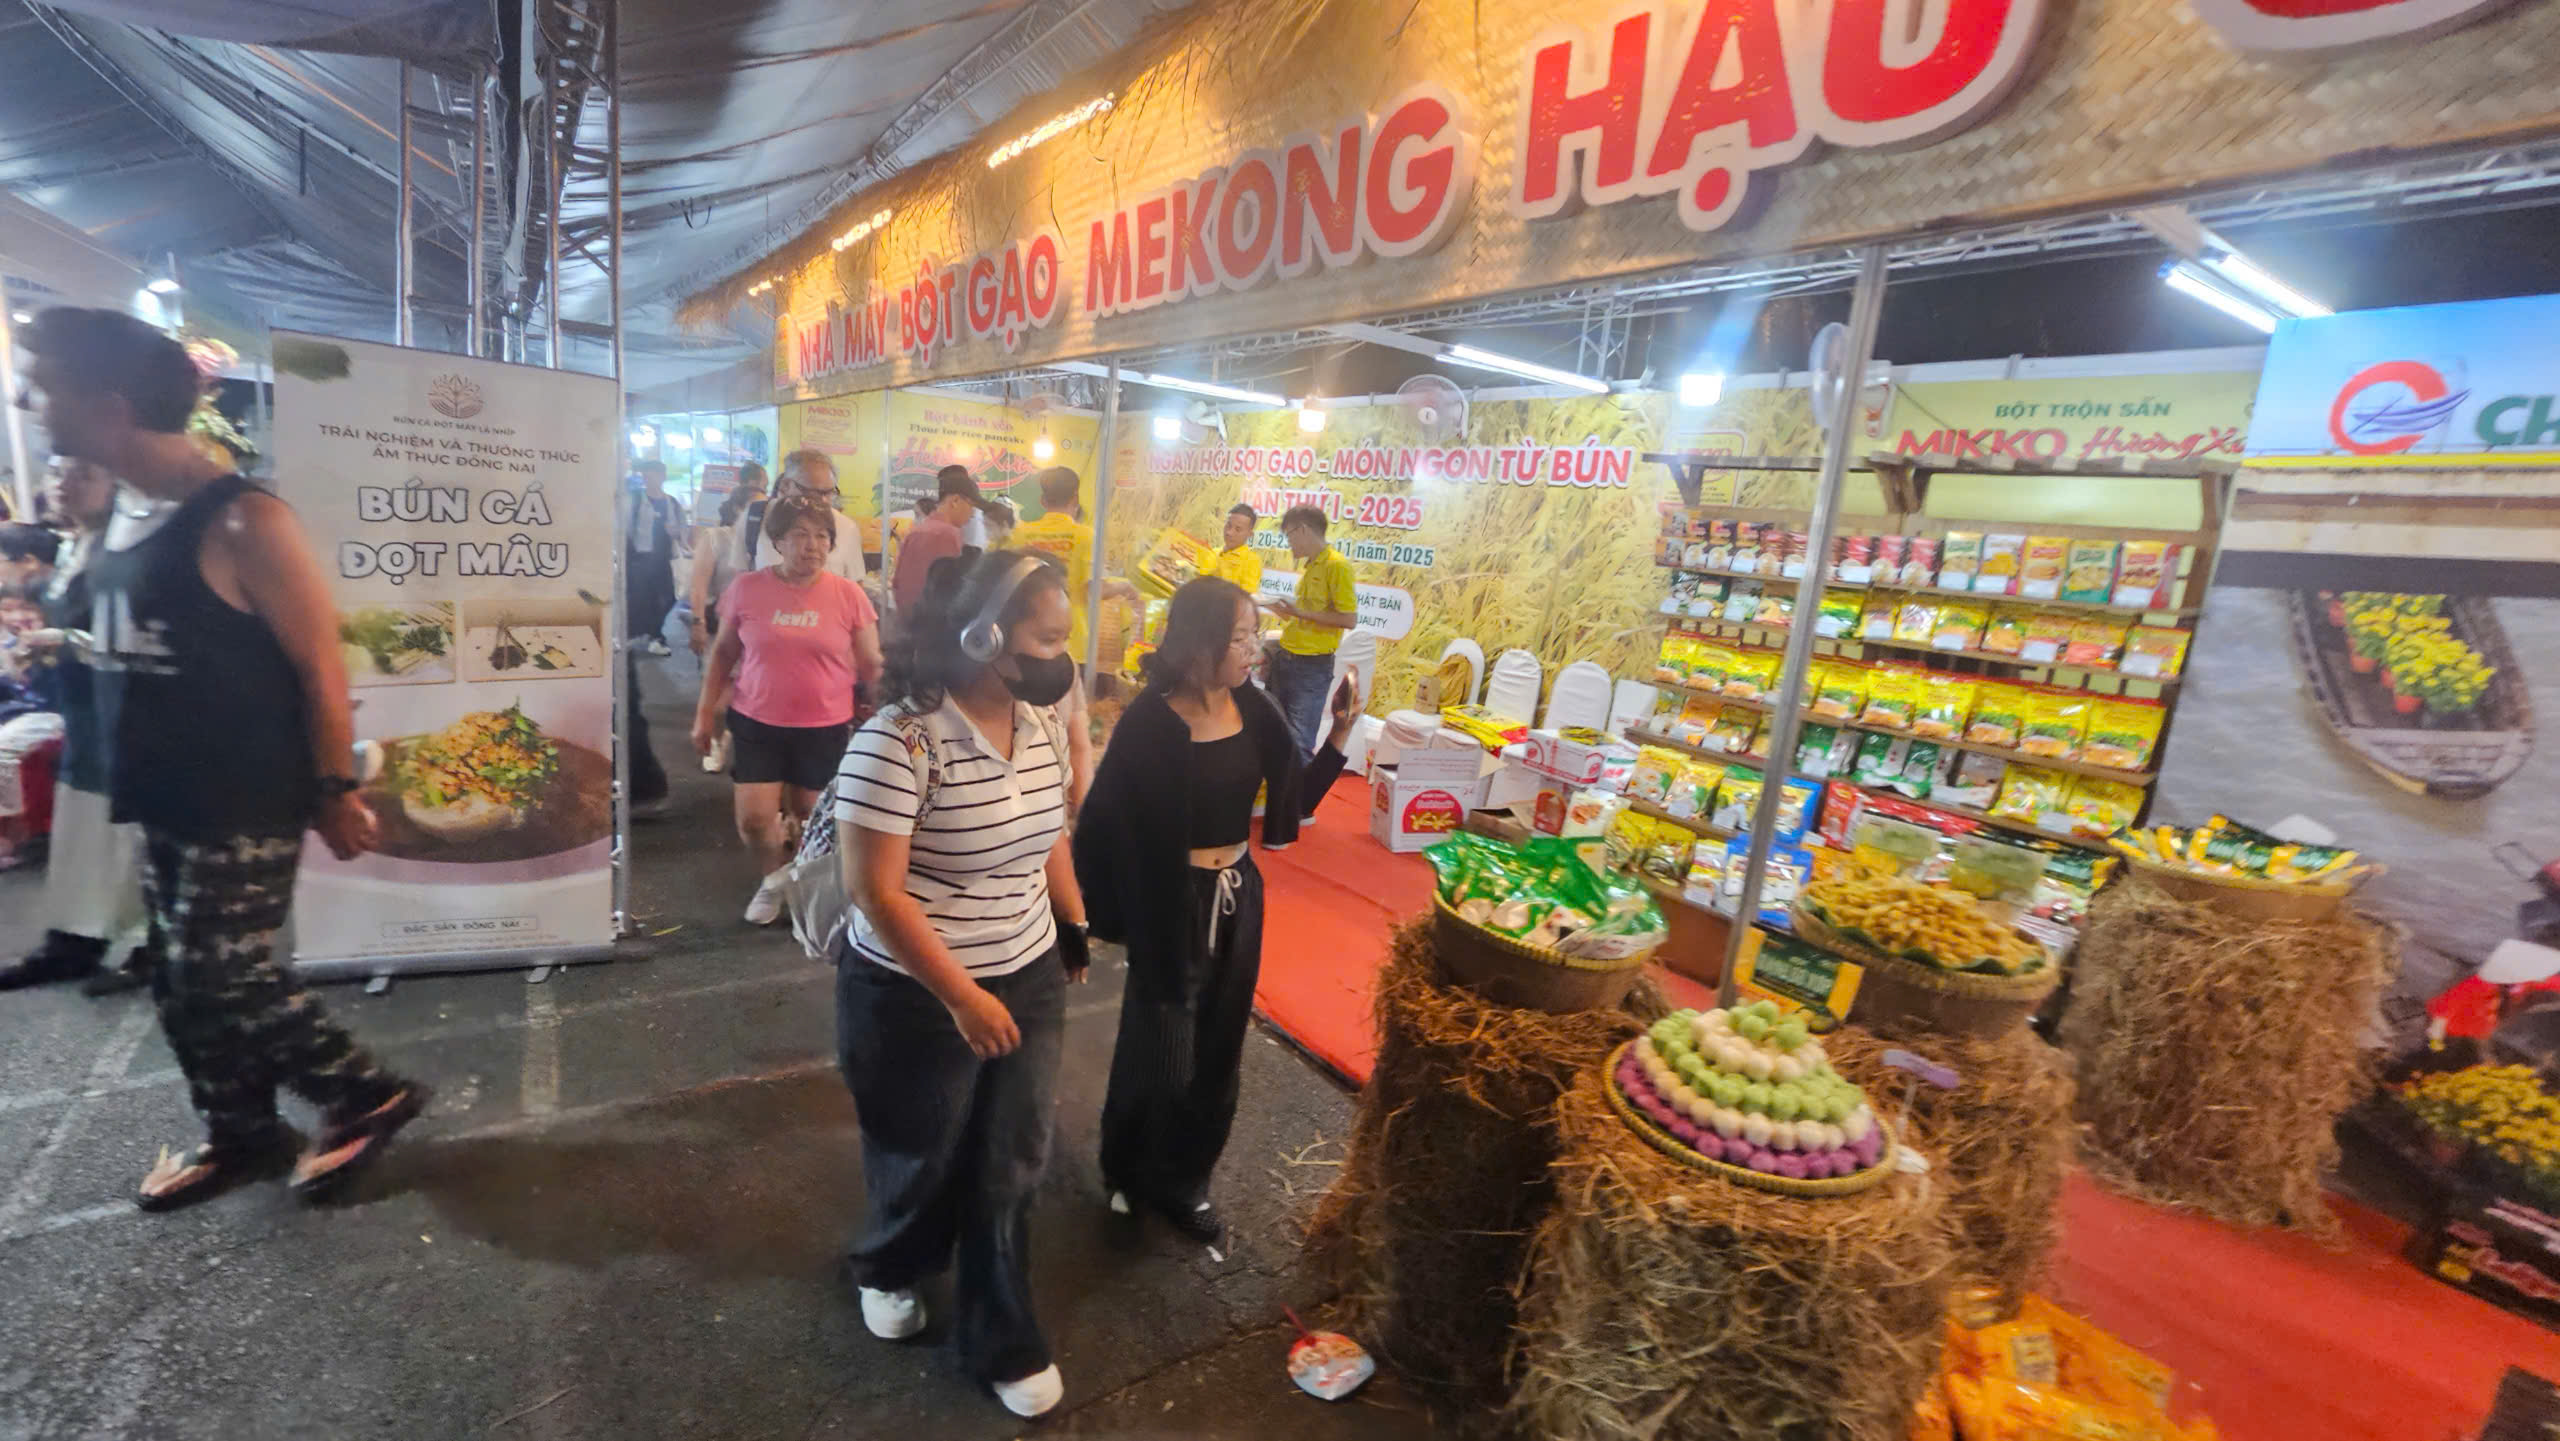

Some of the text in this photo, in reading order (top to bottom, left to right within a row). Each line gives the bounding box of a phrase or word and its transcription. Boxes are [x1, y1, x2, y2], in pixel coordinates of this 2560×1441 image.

[900, 258, 956, 362] BỘT
[968, 235, 1058, 347] GẠO
[1086, 98, 1454, 312] MEKONG
[1995, 399, 2040, 420] BỘT
[2048, 398, 2110, 420] TRỘN
[910, 423, 938, 434] Flour
[942, 426, 957, 435] for
[961, 430, 982, 440] rice
[1896, 428, 2068, 458] MIKKO
[508, 462, 536, 475] NAI
[1200, 441, 1231, 477] HỘI
[1268, 449, 1314, 480] GẠO
[1333, 440, 1392, 477] MÓN
[1400, 448, 1491, 479] NGON
[1500, 440, 1545, 481] TỪ
[1550, 440, 1632, 483] BÚN
[358, 477, 552, 526] BÚN CÁ
[1360, 496, 1422, 528] 2025
[338, 533, 569, 585] ĐỌT MÂY
[1356, 543, 1388, 561] năm
[1393, 545, 1434, 566] 2025
